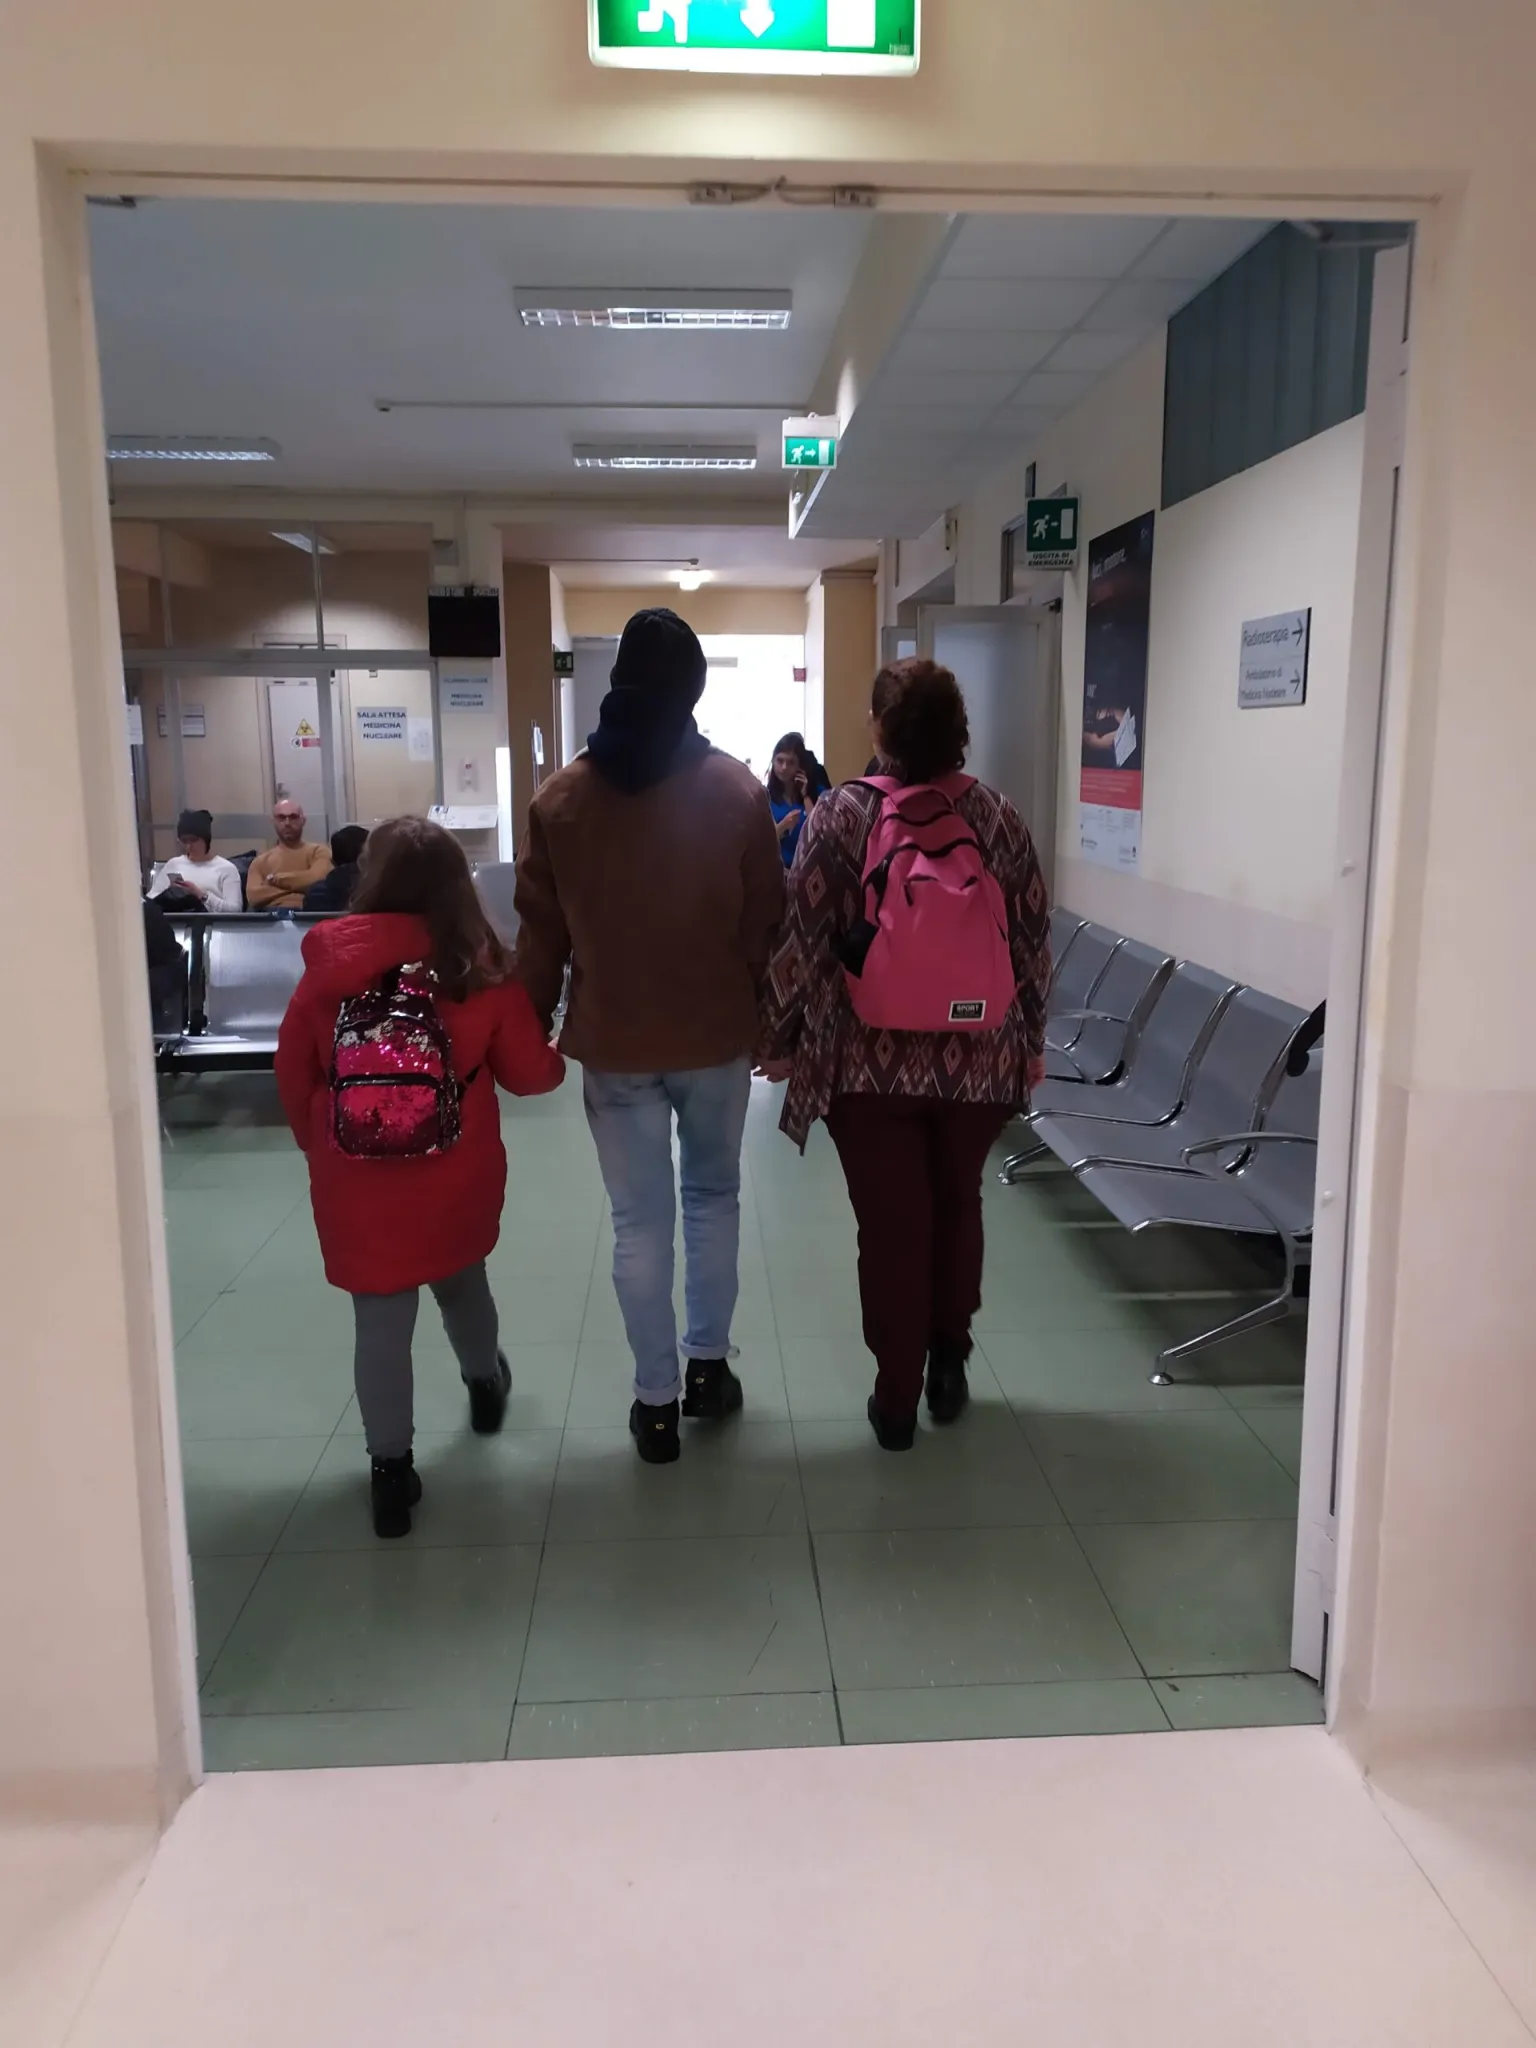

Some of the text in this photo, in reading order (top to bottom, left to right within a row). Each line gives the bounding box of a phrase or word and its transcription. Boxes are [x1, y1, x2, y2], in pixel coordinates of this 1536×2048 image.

[1028, 559, 1073, 567] EMERGENZA
[1243, 628, 1289, 648] Radioterapia
[357, 711, 406, 719] SALA ATTESA
